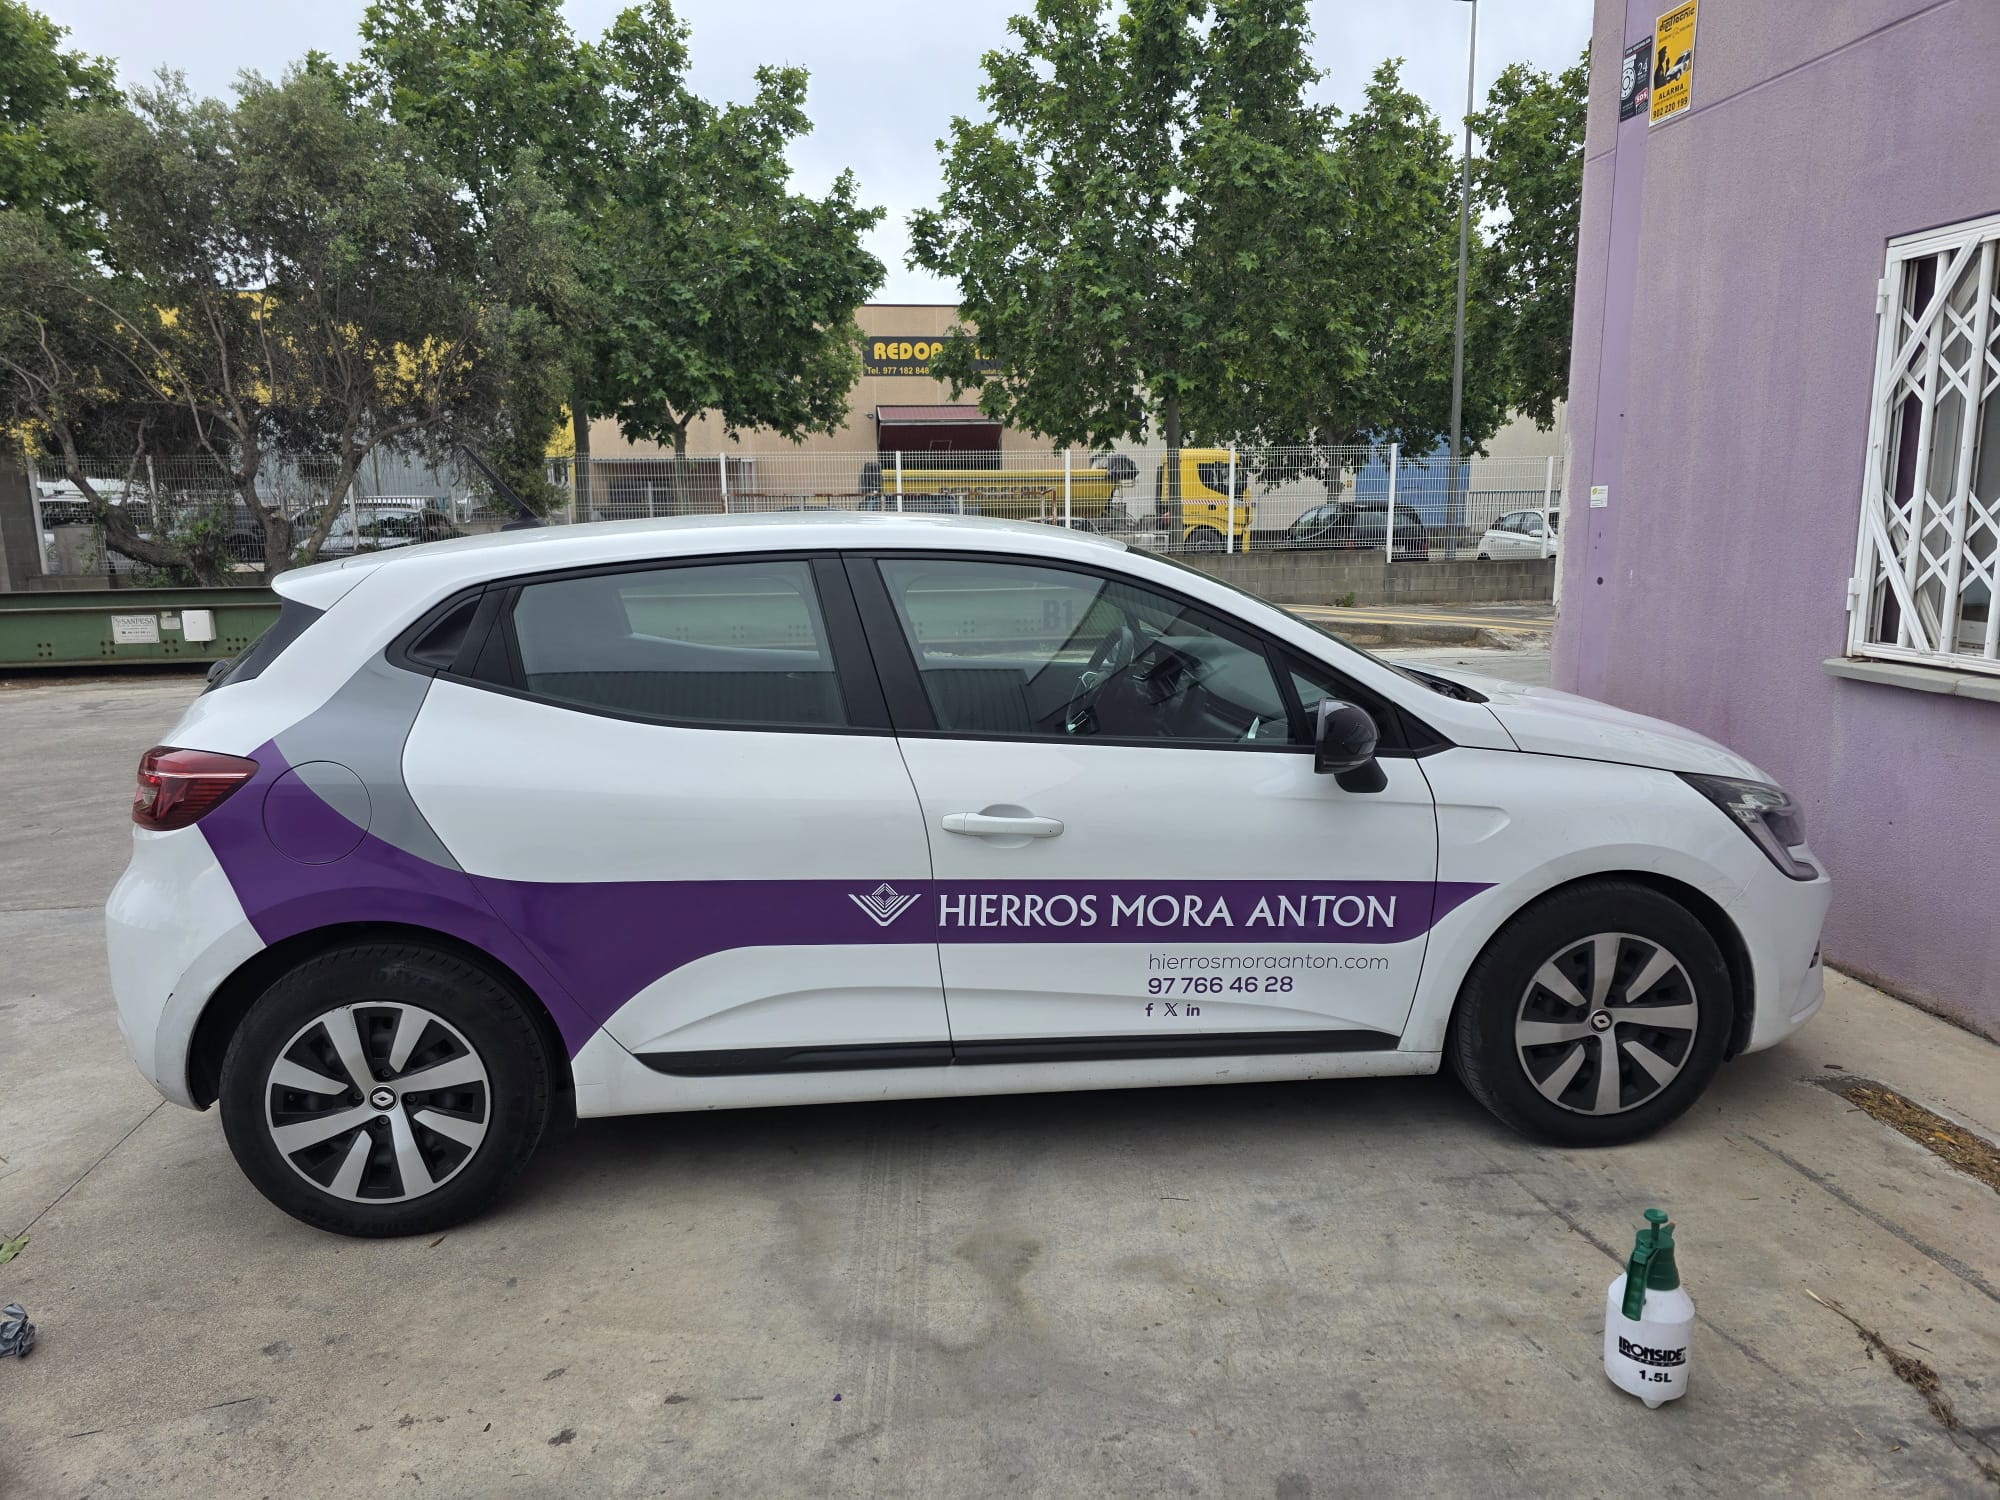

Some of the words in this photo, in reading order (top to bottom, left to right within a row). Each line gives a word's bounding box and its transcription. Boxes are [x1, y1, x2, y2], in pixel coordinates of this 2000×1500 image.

[1658, 83, 1684, 100] ALARMA
[1664, 102, 1675, 113] 220
[867, 366, 880, 375] Tel.
[883, 366, 897, 375] 977
[1043, 600, 1073, 632] B1
[938, 894, 1097, 927] HIERROS
[1110, 894, 1235, 927] MORA
[1245, 895, 1397, 928] ANTON
[1148, 952, 1390, 971] hierrosmoraanton.com
[1147, 976, 1175, 995] 97
[1181, 976, 1223, 995] 766
[1229, 976, 1258, 993] 46
[1264, 976, 1294, 993] 28
[1618, 1335, 1687, 1362] IRONSIDE
[1639, 1370, 1672, 1383] 1.5L
